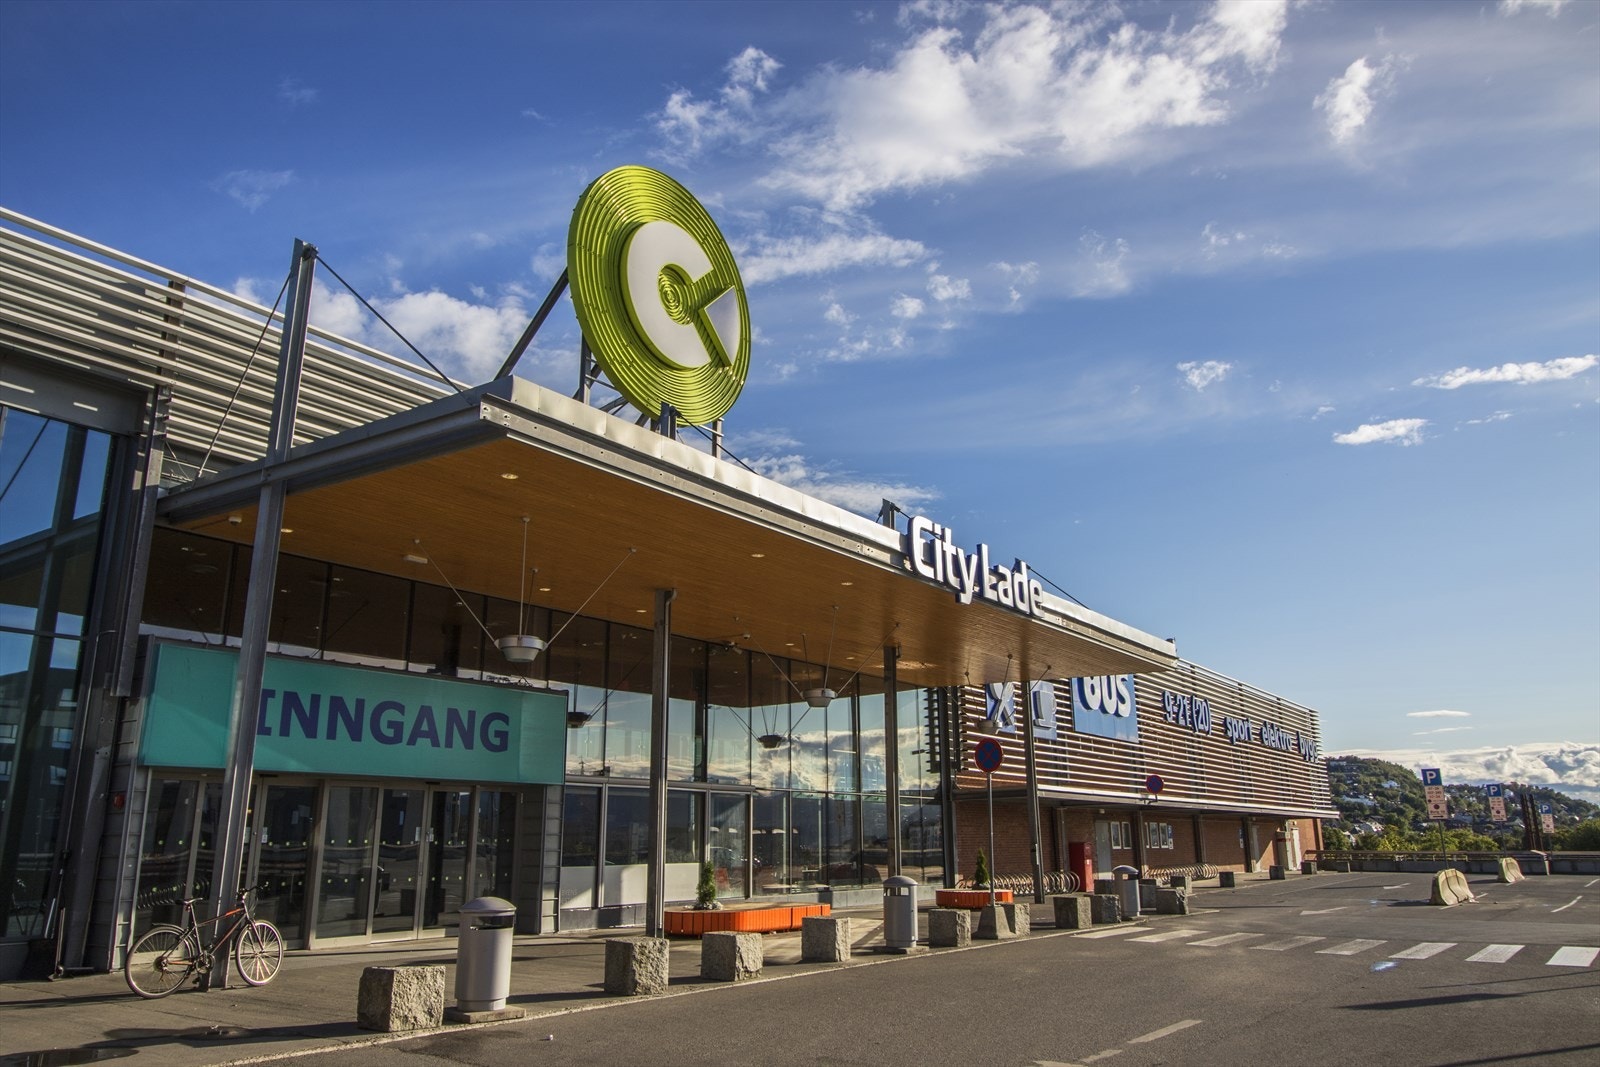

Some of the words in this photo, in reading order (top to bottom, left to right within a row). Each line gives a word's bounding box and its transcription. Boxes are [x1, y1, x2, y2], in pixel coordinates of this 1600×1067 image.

[908, 516, 978, 605] City
[977, 543, 1045, 618] Lade
[257, 688, 510, 753] INNGANG
[1163, 690, 1190, 727] 9-21
[1191, 695, 1212, 736] (20)
[1224, 717, 1253, 745] sport
[1261, 721, 1293, 751] elektro
[1297, 731, 1320, 763] bygg
[1426, 771, 1436, 784] P
[1490, 786, 1498, 796] P
[1542, 805, 1549, 813] P
